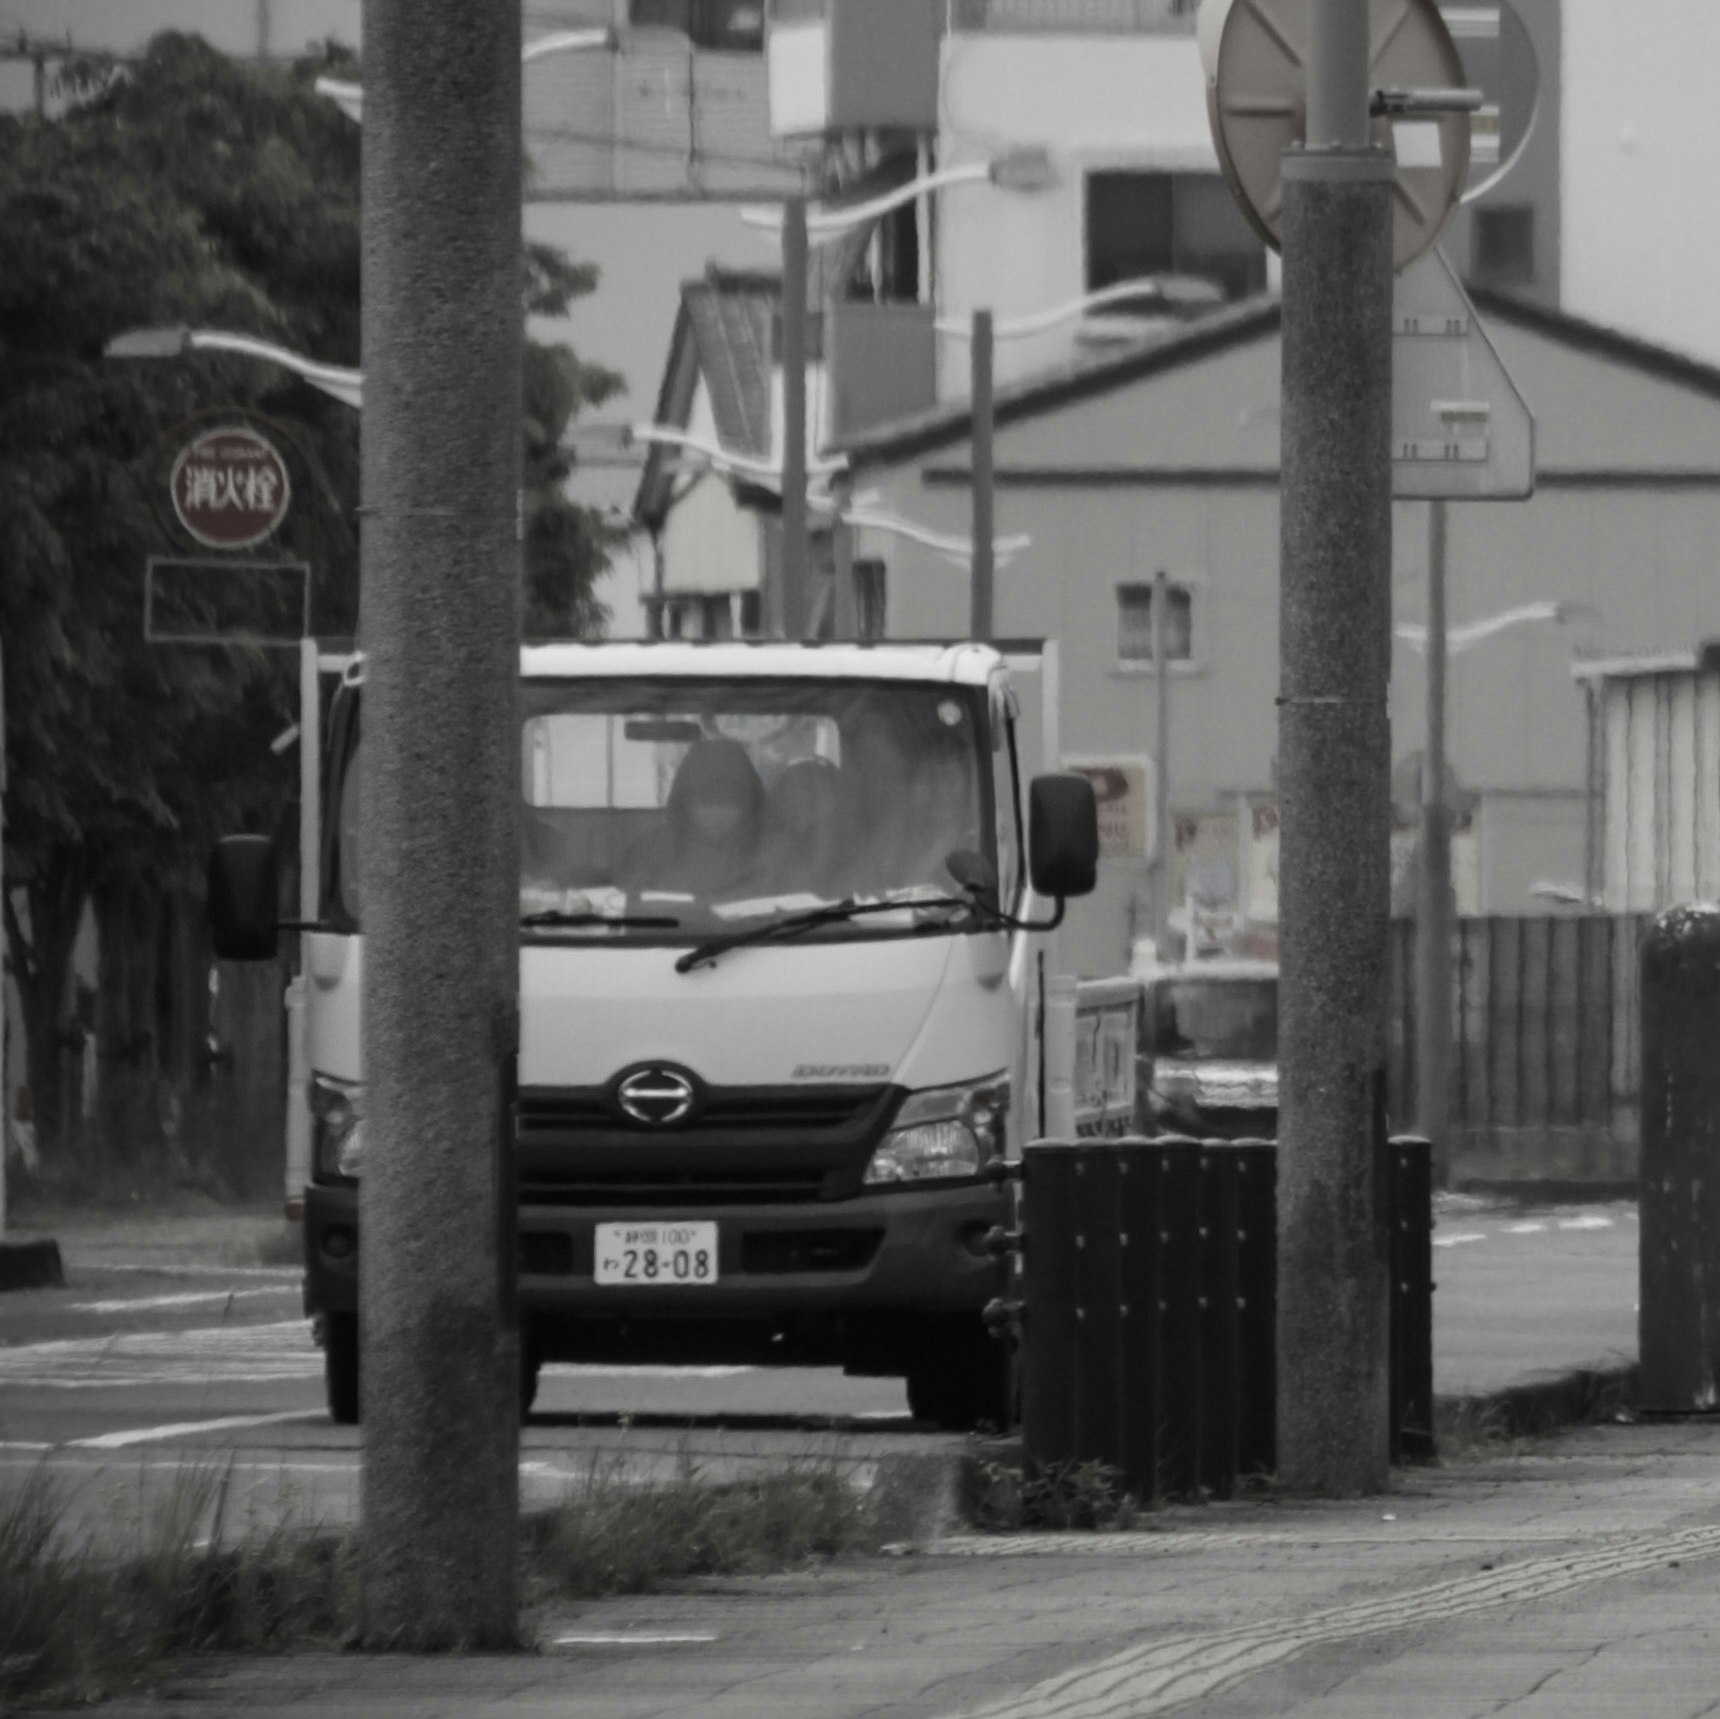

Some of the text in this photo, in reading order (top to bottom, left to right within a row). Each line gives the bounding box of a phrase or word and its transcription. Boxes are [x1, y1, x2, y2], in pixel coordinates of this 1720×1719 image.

[185, 466, 278, 511] 消火栓
[623, 1249, 709, 1278] 28-08
